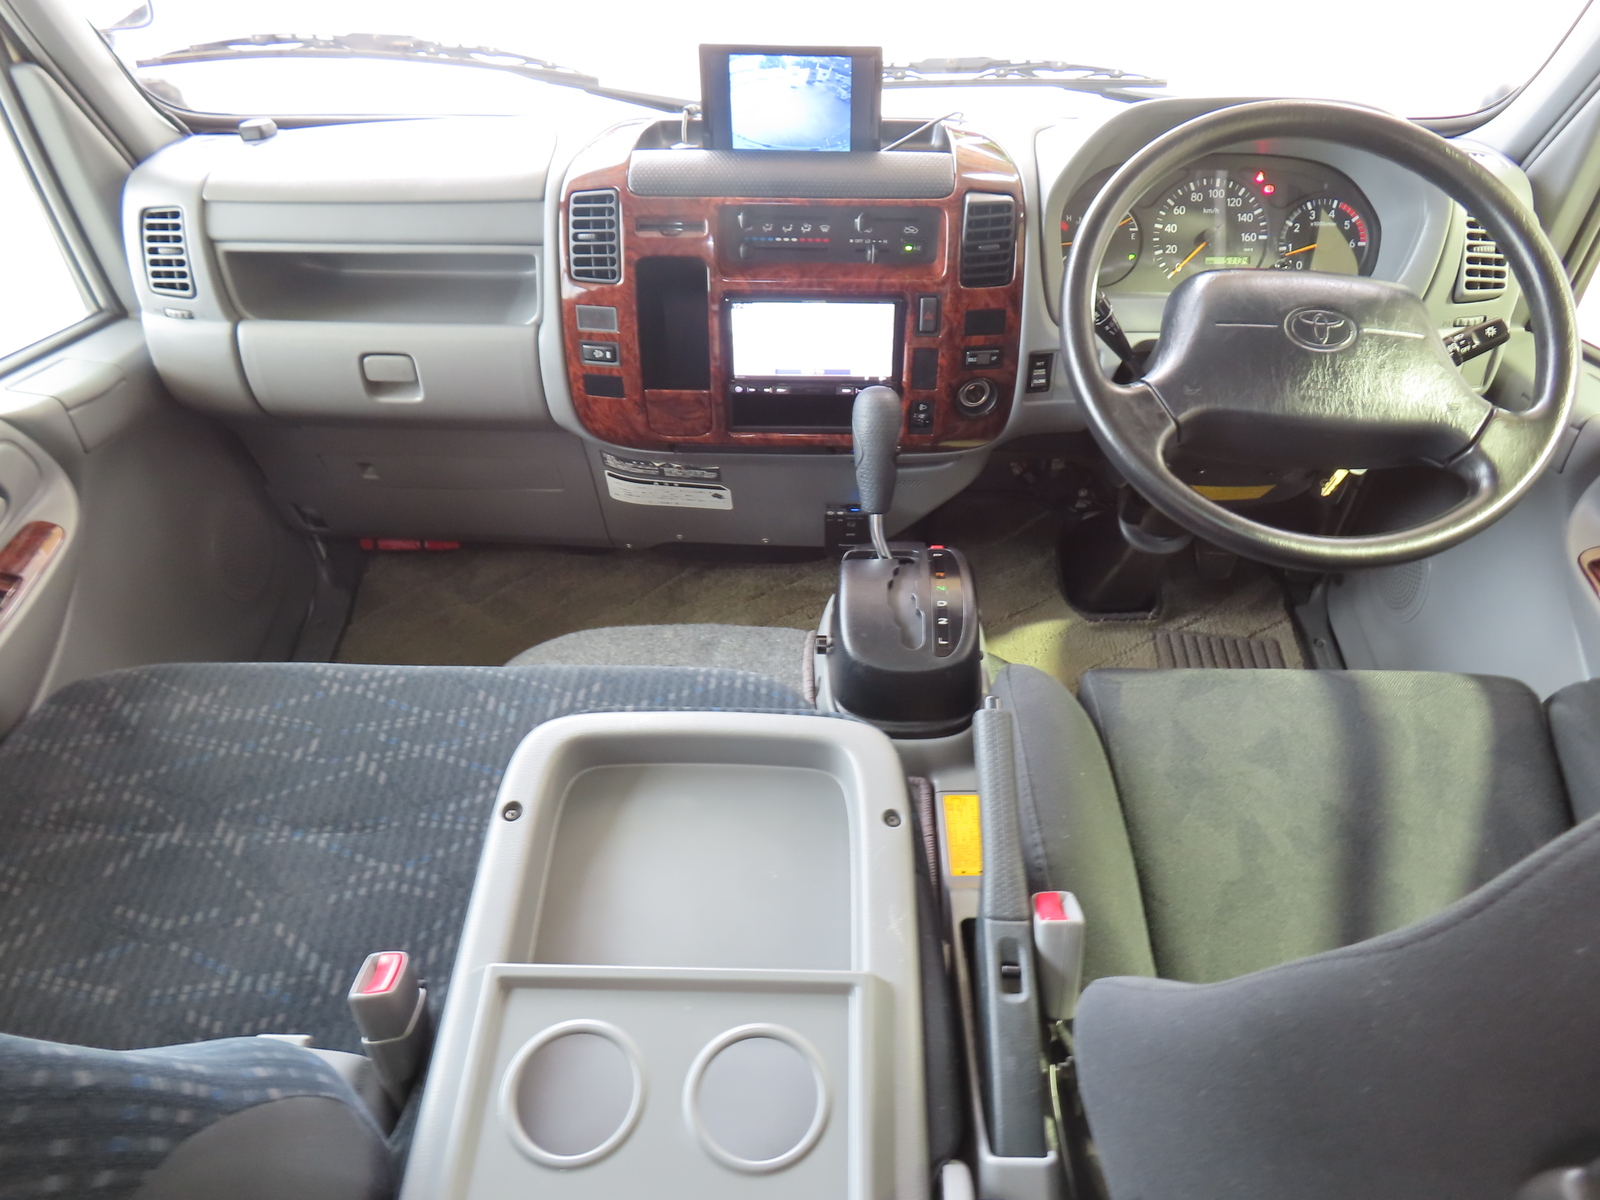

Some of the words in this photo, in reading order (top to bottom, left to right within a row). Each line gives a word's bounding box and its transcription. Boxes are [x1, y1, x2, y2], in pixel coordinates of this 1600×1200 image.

[1190, 192, 1203, 202] 80
[1208, 189, 1225, 198] 100
[1226, 198, 1242, 207] 120
[1173, 206, 1186, 215] 60
[1309, 210, 1316, 220] 3
[1328, 209, 1336, 218] 4
[1237, 213, 1253, 222] 140
[1164, 224, 1178, 233] 40
[1293, 223, 1300, 233] 2
[1344, 220, 1350, 230] 5
[1241, 233, 1257, 242] 160
[1288, 243, 1292, 252] 1
[1349, 239, 1356, 248] 6
[1165, 244, 1178, 254] 20
[1296, 260, 1302, 270] 0
